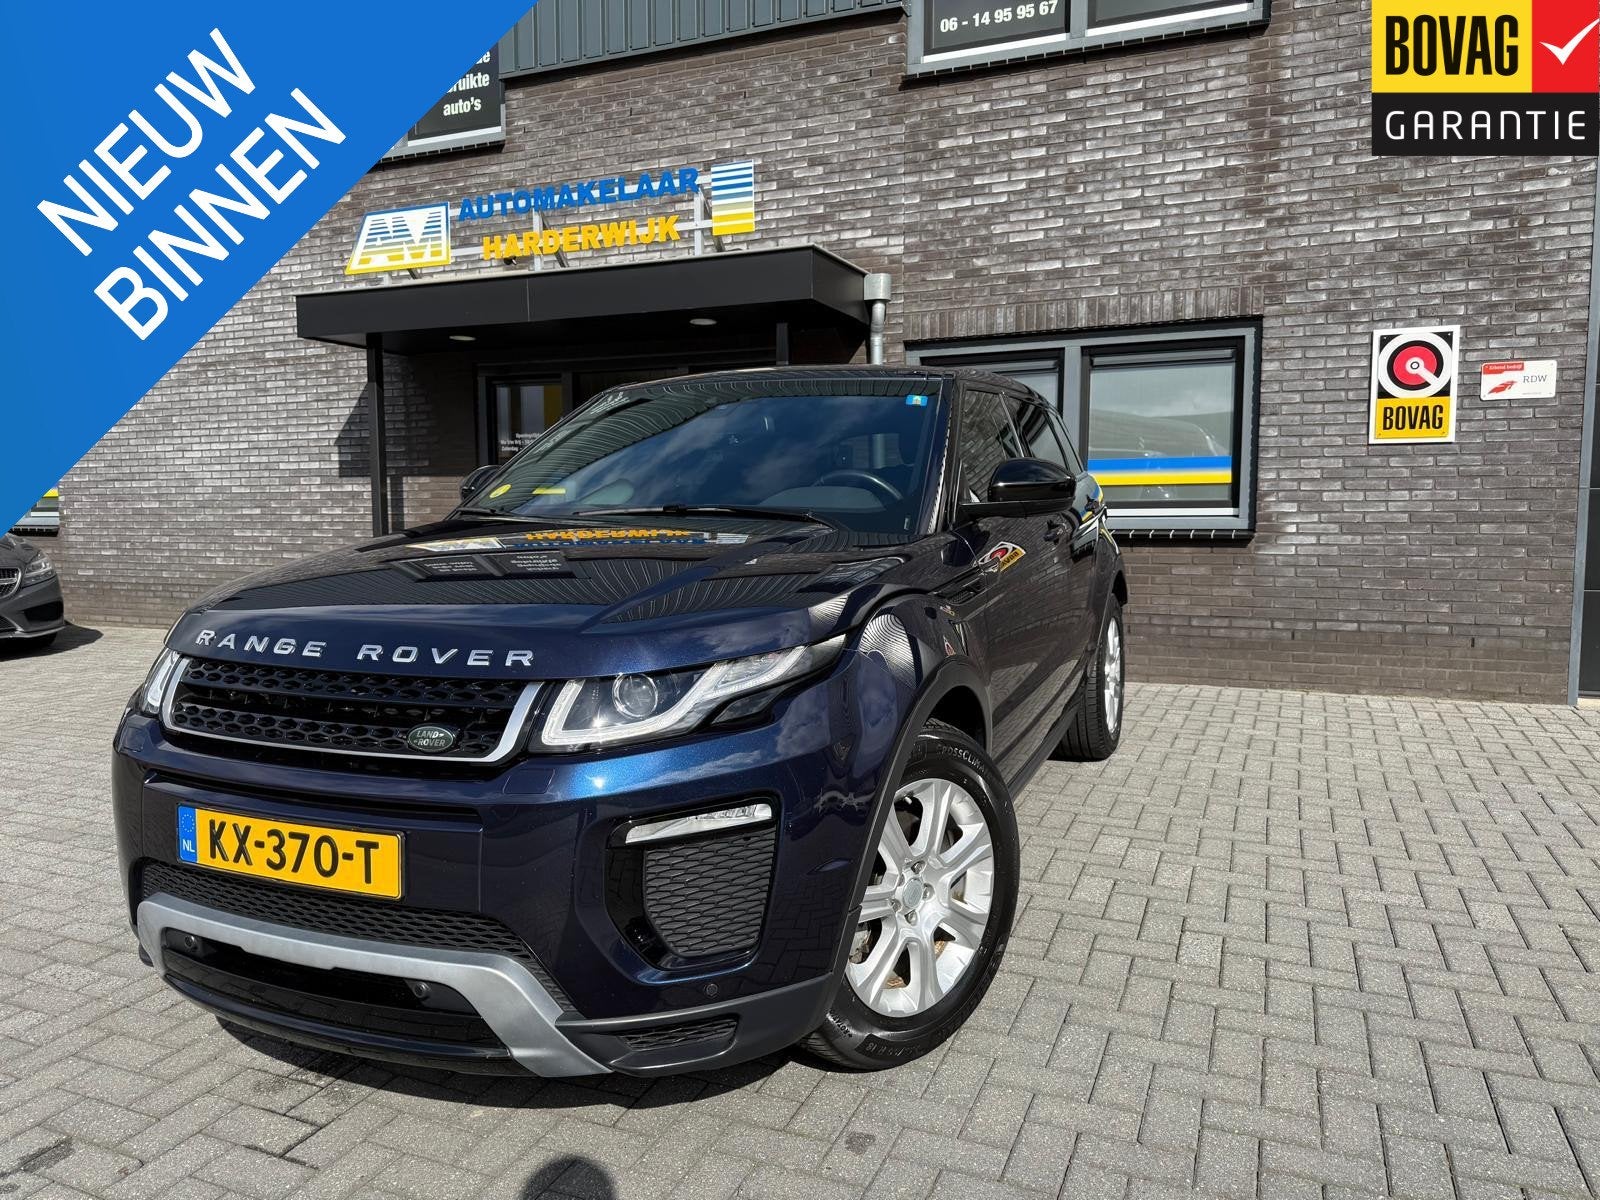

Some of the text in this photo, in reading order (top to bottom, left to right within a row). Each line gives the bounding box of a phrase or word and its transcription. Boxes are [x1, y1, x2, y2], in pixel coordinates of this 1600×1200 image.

[940, 17, 958, 33] 06
[972, 12, 990, 27] 14
[994, 7, 1012, 24] 95
[1016, 3, 1035, 20] 95
[1039, 0, 1058, 16] 67
[443, 97, 482, 116] auto's
[458, 167, 701, 221] AUTOMAKELAAR
[482, 215, 681, 260] HARDERWIJK
[1523, 374, 1548, 384] RDW
[1382, 404, 1444, 431] BOVAG
[196, 629, 535, 668] RANGE ROVER
[416, 730, 439, 739] LAND
[417, 738, 446, 747] ROVER
[182, 839, 196, 853] NL
[209, 818, 380, 885] KX-370-T
